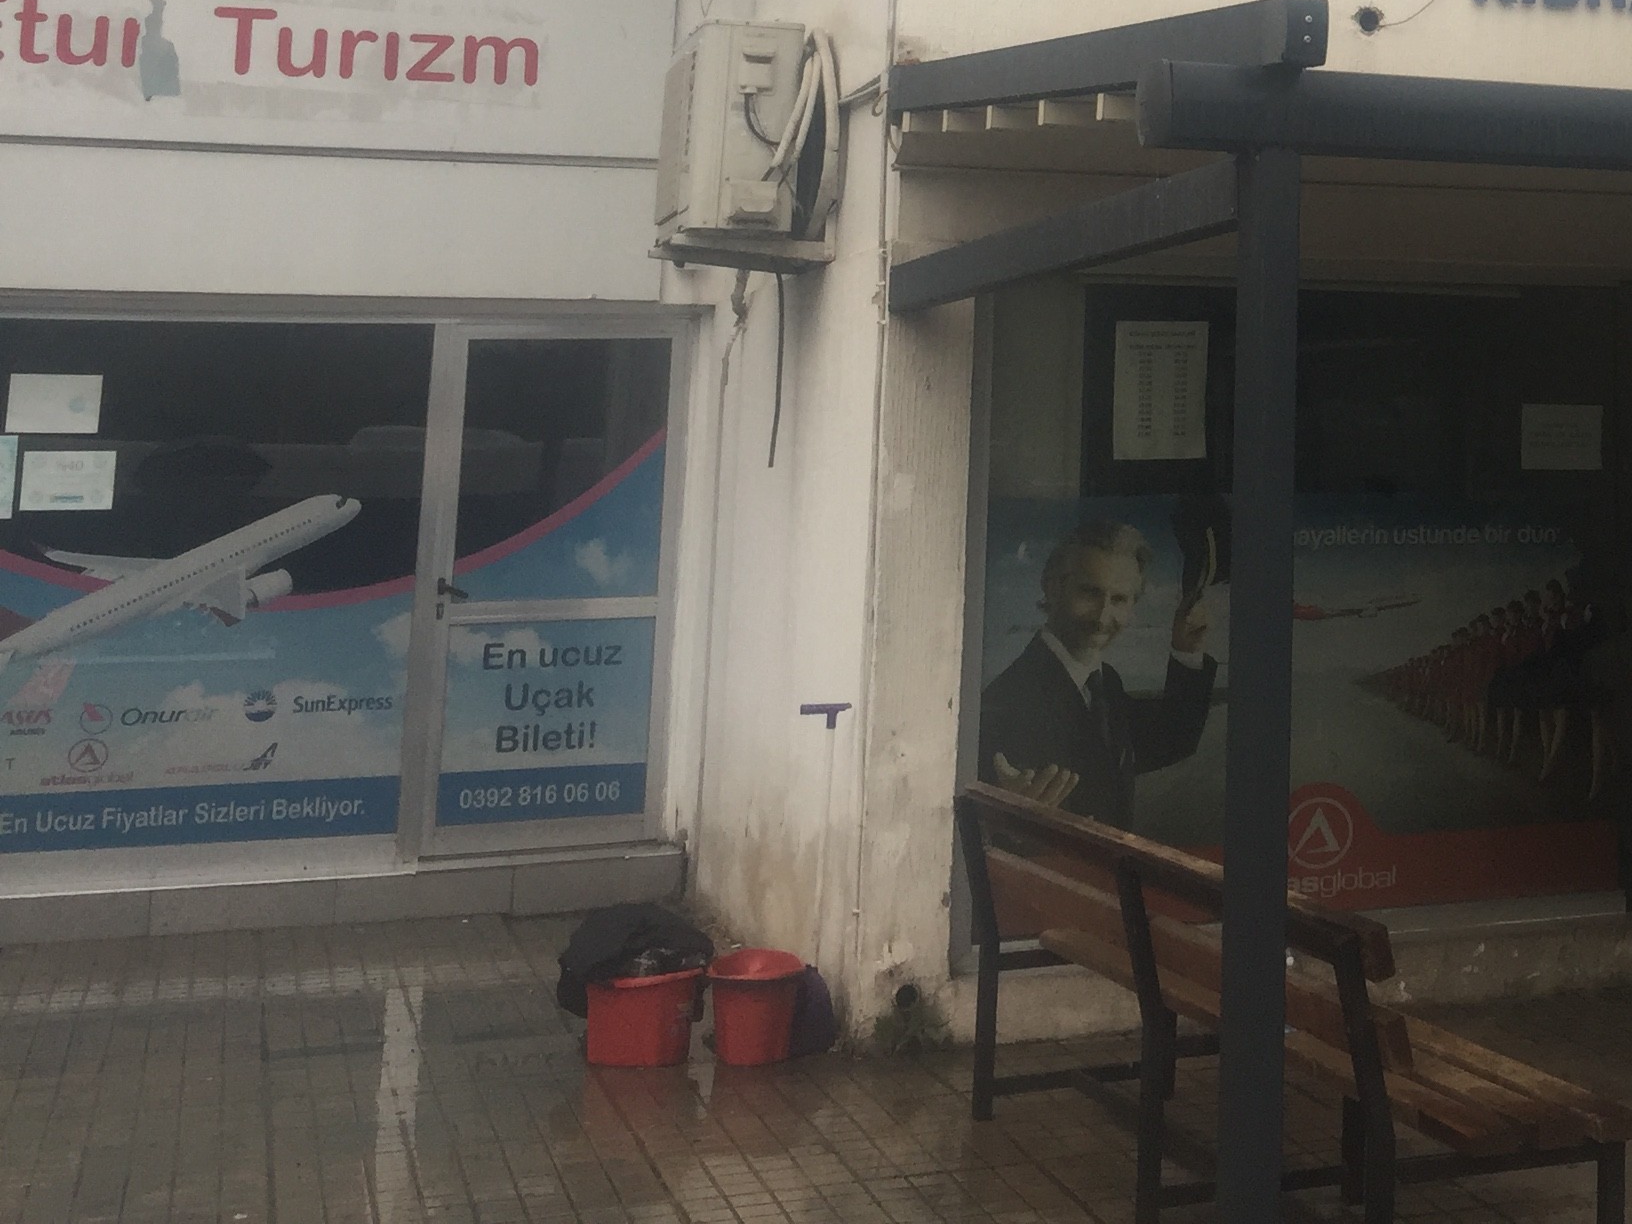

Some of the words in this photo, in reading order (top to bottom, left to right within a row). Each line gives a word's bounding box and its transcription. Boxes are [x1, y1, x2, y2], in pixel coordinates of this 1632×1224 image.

[482, 642, 527, 670] En
[539, 645, 623, 668] ucuz
[293, 694, 393, 715] SunExpress
[505, 680, 594, 716] Uçak
[495, 721, 597, 753] Bileti!
[459, 787, 512, 809] 0392
[518, 784, 557, 806] 816
[563, 782, 589, 803] 06
[595, 780, 621, 801] 06
[0, 813, 28, 835] En
[35, 810, 95, 832] Ucuz
[102, 805, 189, 834] Fiyatlar
[194, 799, 265, 825] Sizleri
[272, 795, 366, 823] Bekliyor.
